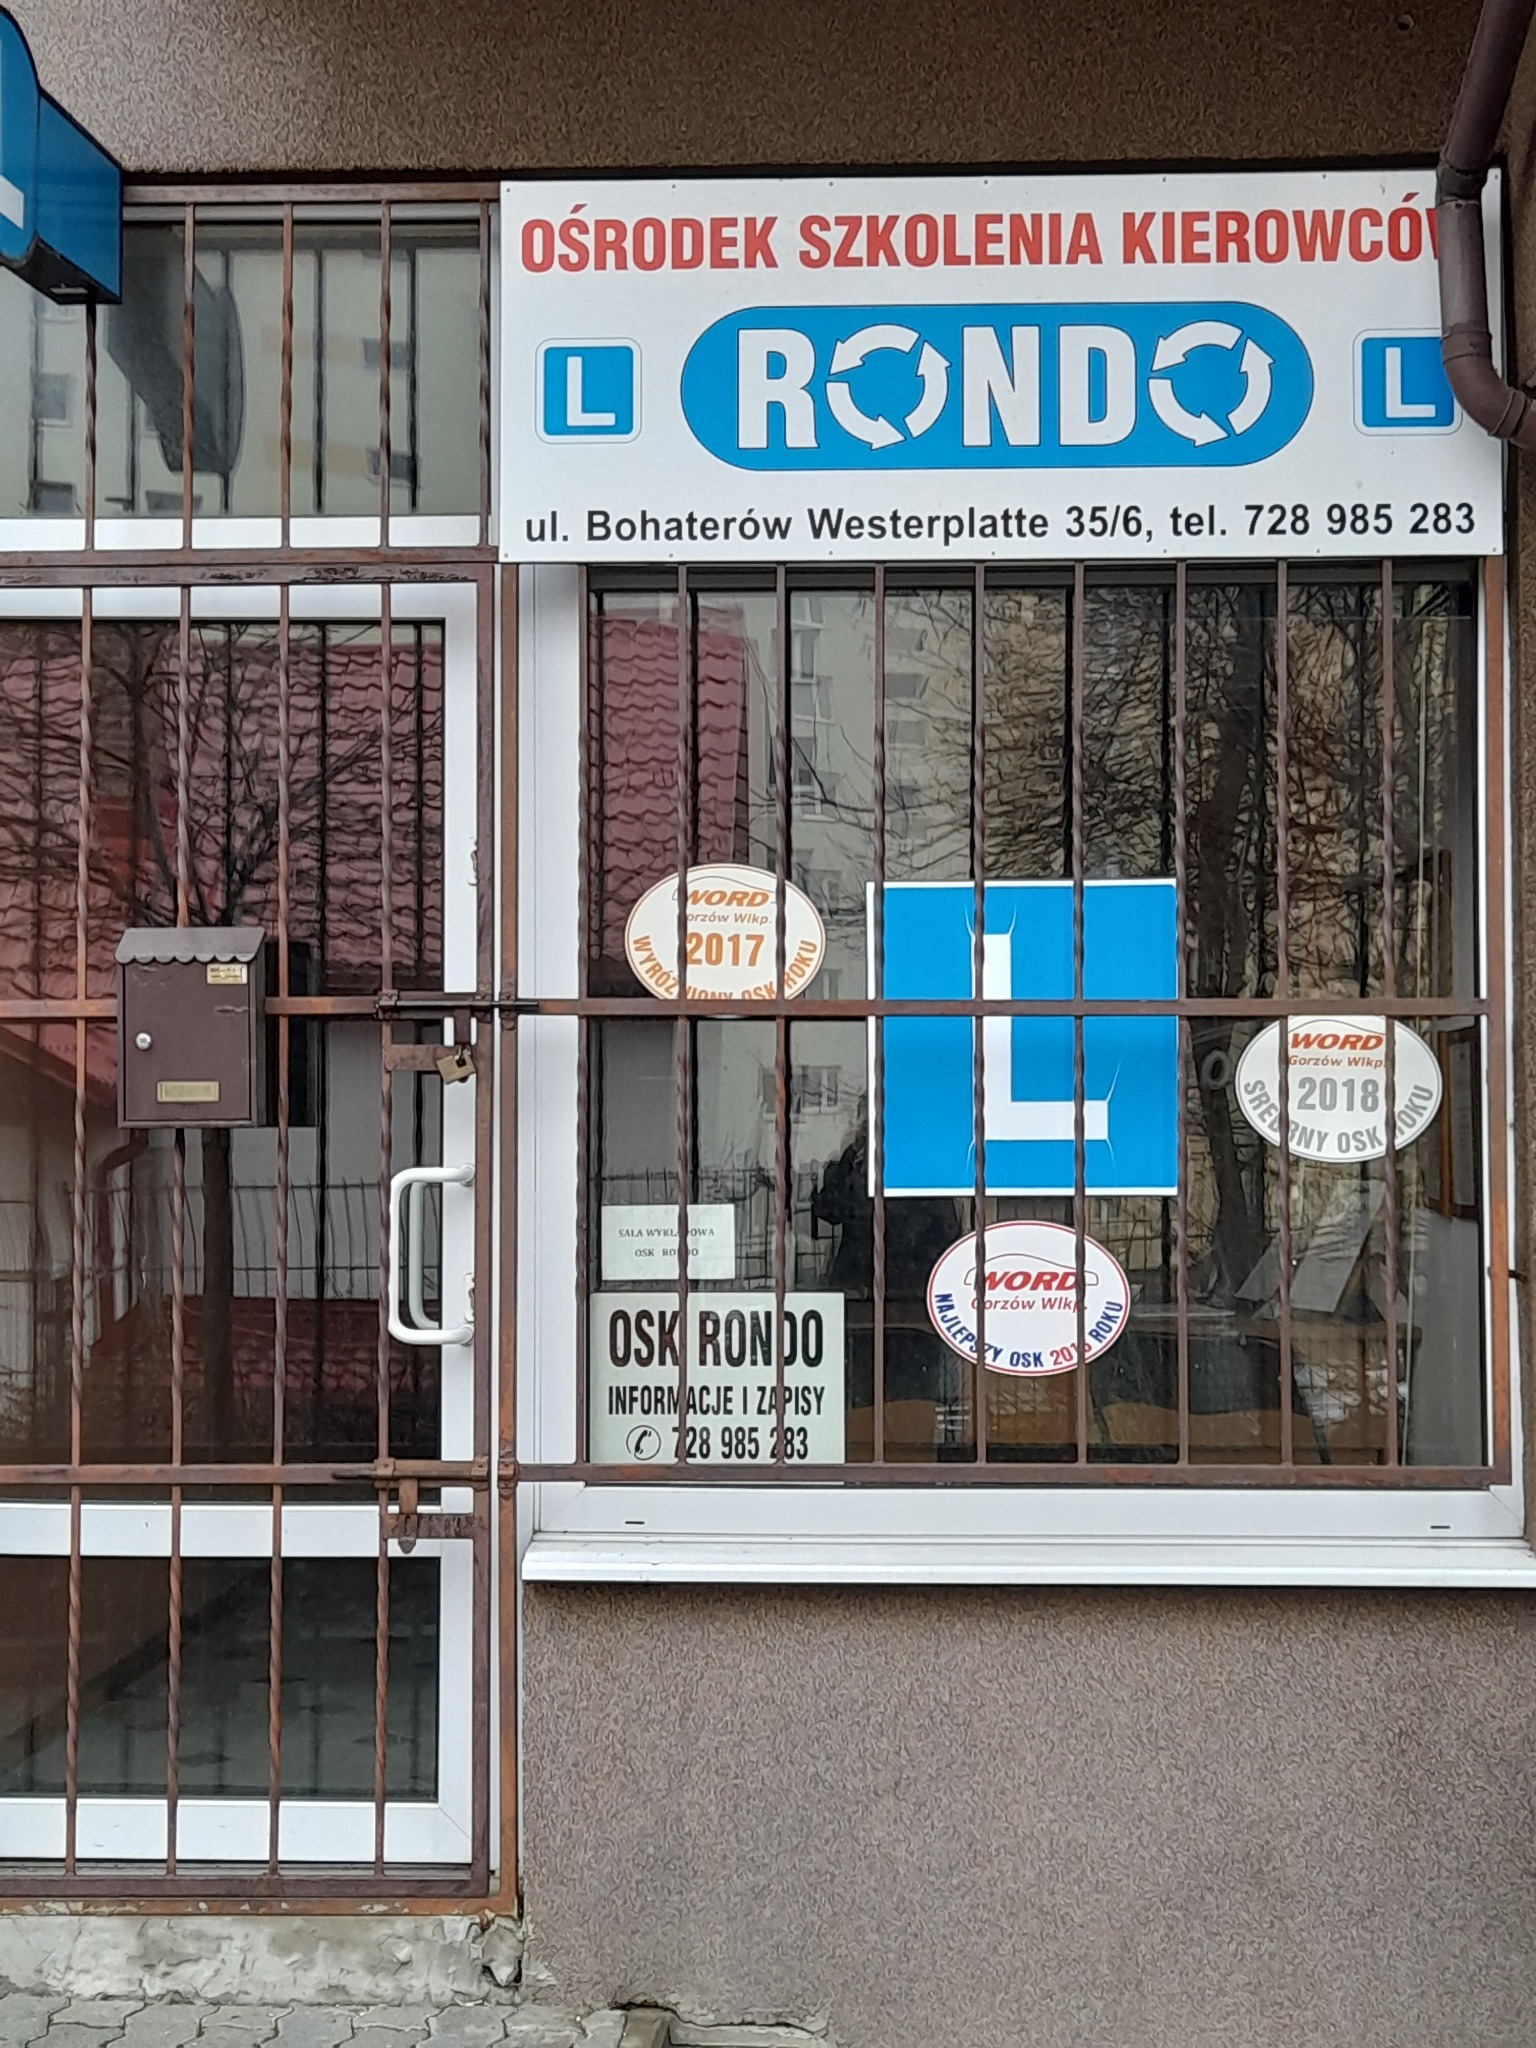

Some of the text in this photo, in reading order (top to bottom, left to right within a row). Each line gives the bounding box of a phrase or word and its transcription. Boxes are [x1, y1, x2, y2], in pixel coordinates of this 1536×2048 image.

[521, 192, 1440, 273] OŚRODEK SZKOLENIA KIEROWCÓ
[566, 355, 616, 427] L
[1385, 346, 1437, 418] L
[525, 502, 1476, 546] ul. Bohaterów Westerplatte 35/6, tel. 728 985 283
[687, 890, 770, 907] WORD
[680, 911, 730, 923] orzów
[686, 932, 765, 967] 2017
[971, 934, 1108, 1140] L
[1291, 1033, 1384, 1050] WORD
[1288, 1055, 1343, 1066] Gorzów
[1296, 1076, 1379, 1112] 2018
[1337, 1125, 1384, 1154] OSK
[609, 1309, 824, 1368] OSK RONDO
[1009, 1351, 1044, 1368] OSK
[1087, 1301, 1123, 1343] ROKU
[608, 1385, 733, 1416] INFORMACJE
[742, 1386, 748, 1415] I
[721, 1426, 760, 1459] 985
